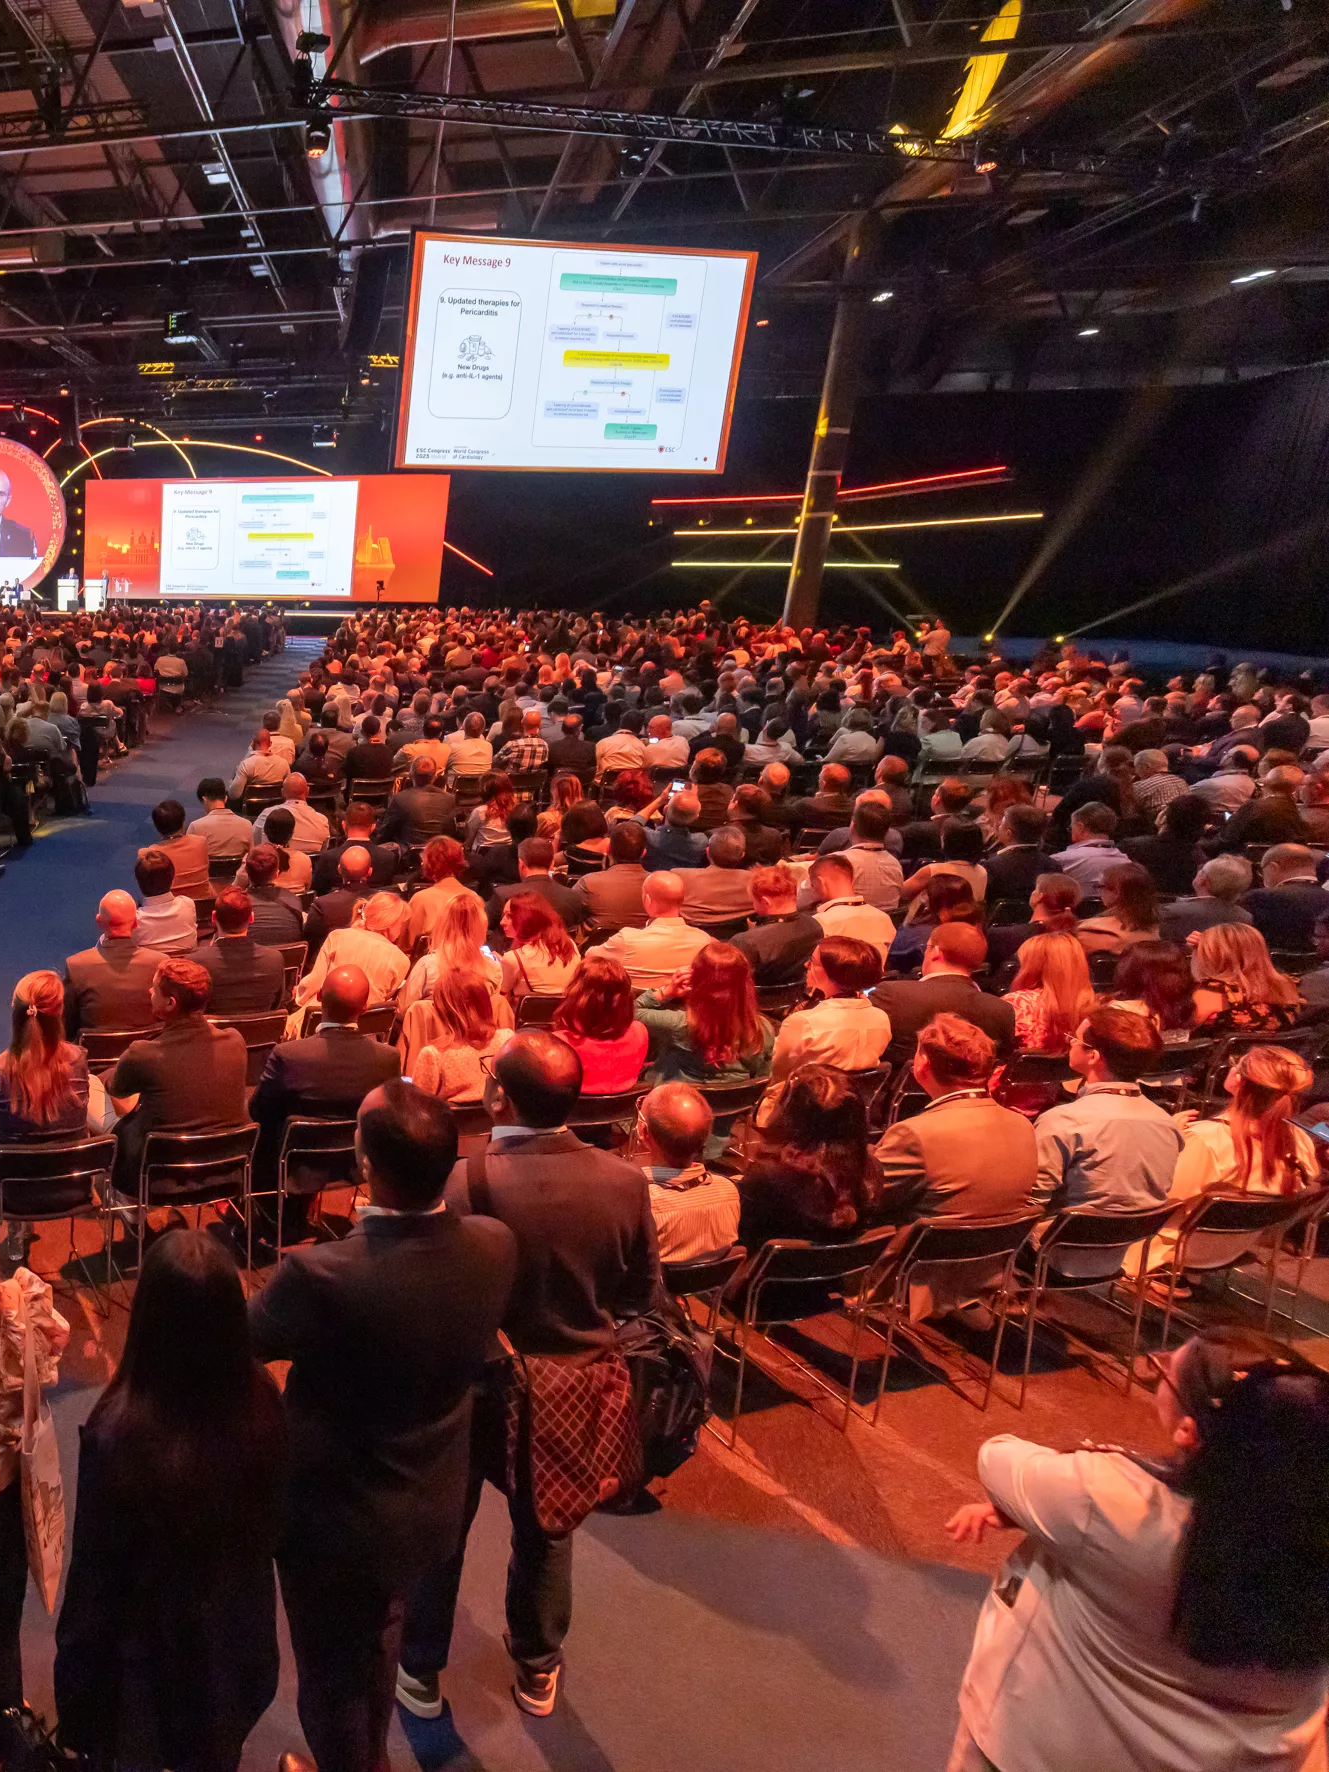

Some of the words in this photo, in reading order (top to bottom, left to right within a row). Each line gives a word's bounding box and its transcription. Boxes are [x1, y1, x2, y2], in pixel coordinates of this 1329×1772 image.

[443, 254, 460, 266] Key
[463, 256, 503, 268] Message
[505, 258, 511, 267] 9
[448, 297, 476, 305] Updated
[478, 299, 509, 307] therapies
[460, 308, 498, 316] Pericarditis
[482, 373, 503, 381] agents)
